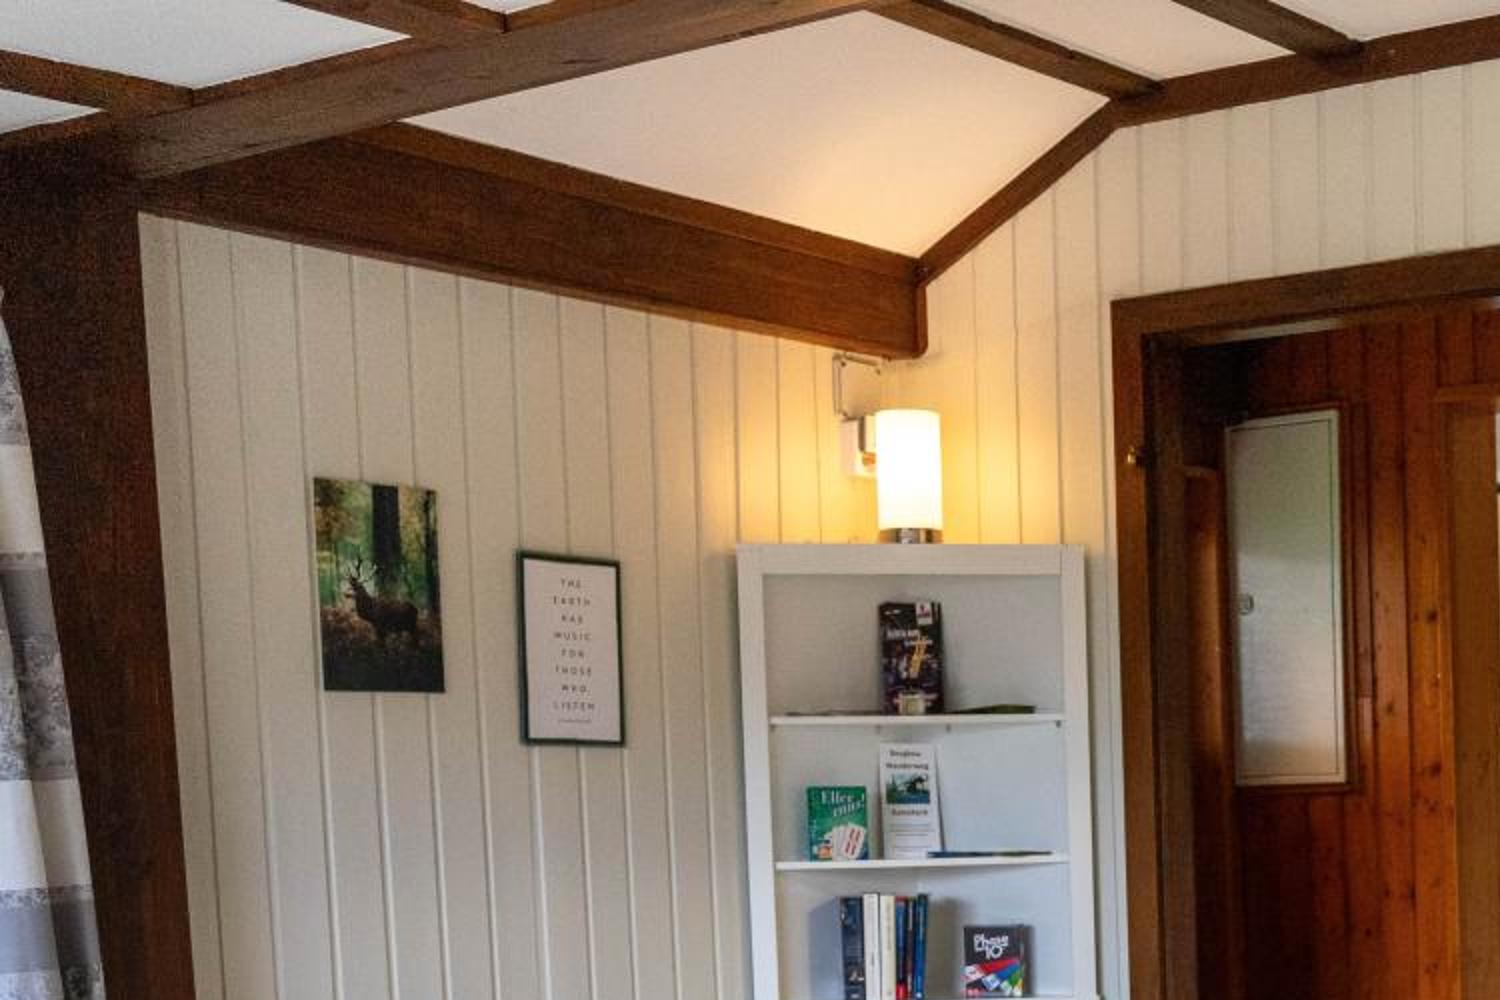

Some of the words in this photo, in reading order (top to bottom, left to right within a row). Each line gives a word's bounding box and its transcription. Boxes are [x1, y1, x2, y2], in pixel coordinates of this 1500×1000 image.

[561, 579, 581, 589] THE
[553, 595, 590, 605] EARTH
[561, 614, 583, 624] HAS
[553, 631, 591, 641] MUSIC
[561, 648, 584, 658] FOR
[555, 664, 591, 677] THOSE
[561, 684, 587, 693] WHO
[553, 700, 595, 711] LISTEN
[973, 933, 1008, 952] Phase
[985, 945, 1003, 960] 10
